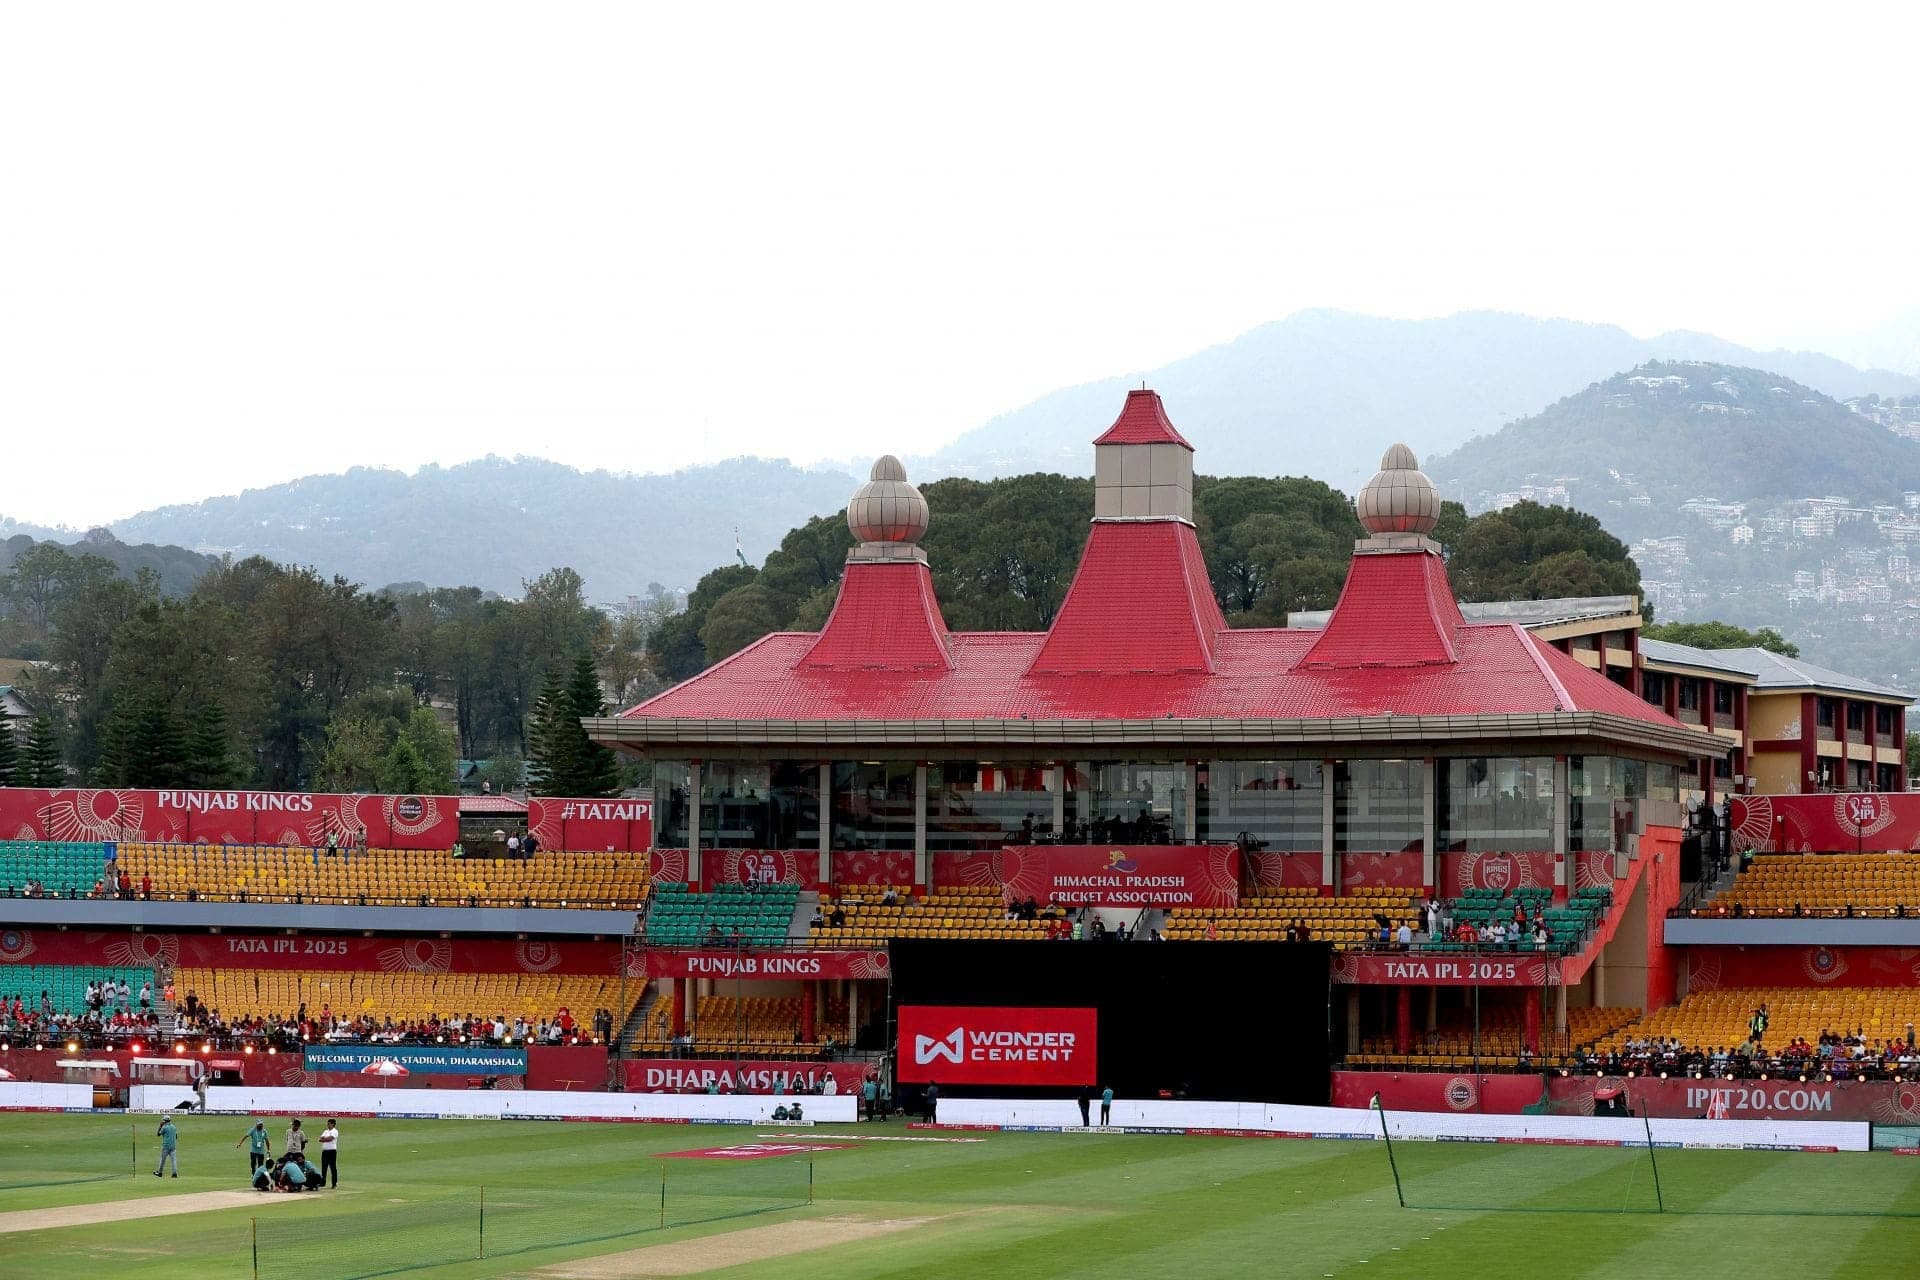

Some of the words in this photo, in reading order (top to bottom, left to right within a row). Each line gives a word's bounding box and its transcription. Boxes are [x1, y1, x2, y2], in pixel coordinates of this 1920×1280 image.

[158, 791, 238, 813] PUNJAB
[246, 793, 313, 812] KINGS
[1860, 808, 1877, 819] IPL
[759, 869, 780, 883] IPL
[1054, 876, 1122, 887] HIMACHAL
[1126, 876, 1185, 887] PRADESH
[1049, 891, 1103, 903] CRICKET
[1106, 892, 1193, 903] ASSOCIATION
[226, 939, 269, 953] TATA
[273, 940, 299, 953] IPL
[304, 940, 348, 955] 2025
[687, 957, 757, 976] PUNJAB
[763, 958, 821, 973] KINGS
[1384, 962, 1429, 978] TATA
[1435, 963, 1462, 979] IPL
[1468, 963, 1516, 979] 2025
[969, 1031, 1076, 1047] WONDER
[308, 1054, 355, 1063] WELCOME
[357, 1055, 370, 1063] TO
[401, 1056, 448, 1065] STADIUM,
[450, 1056, 524, 1066] DHARAMSHALA
[971, 1049, 1073, 1061] CEMENT
